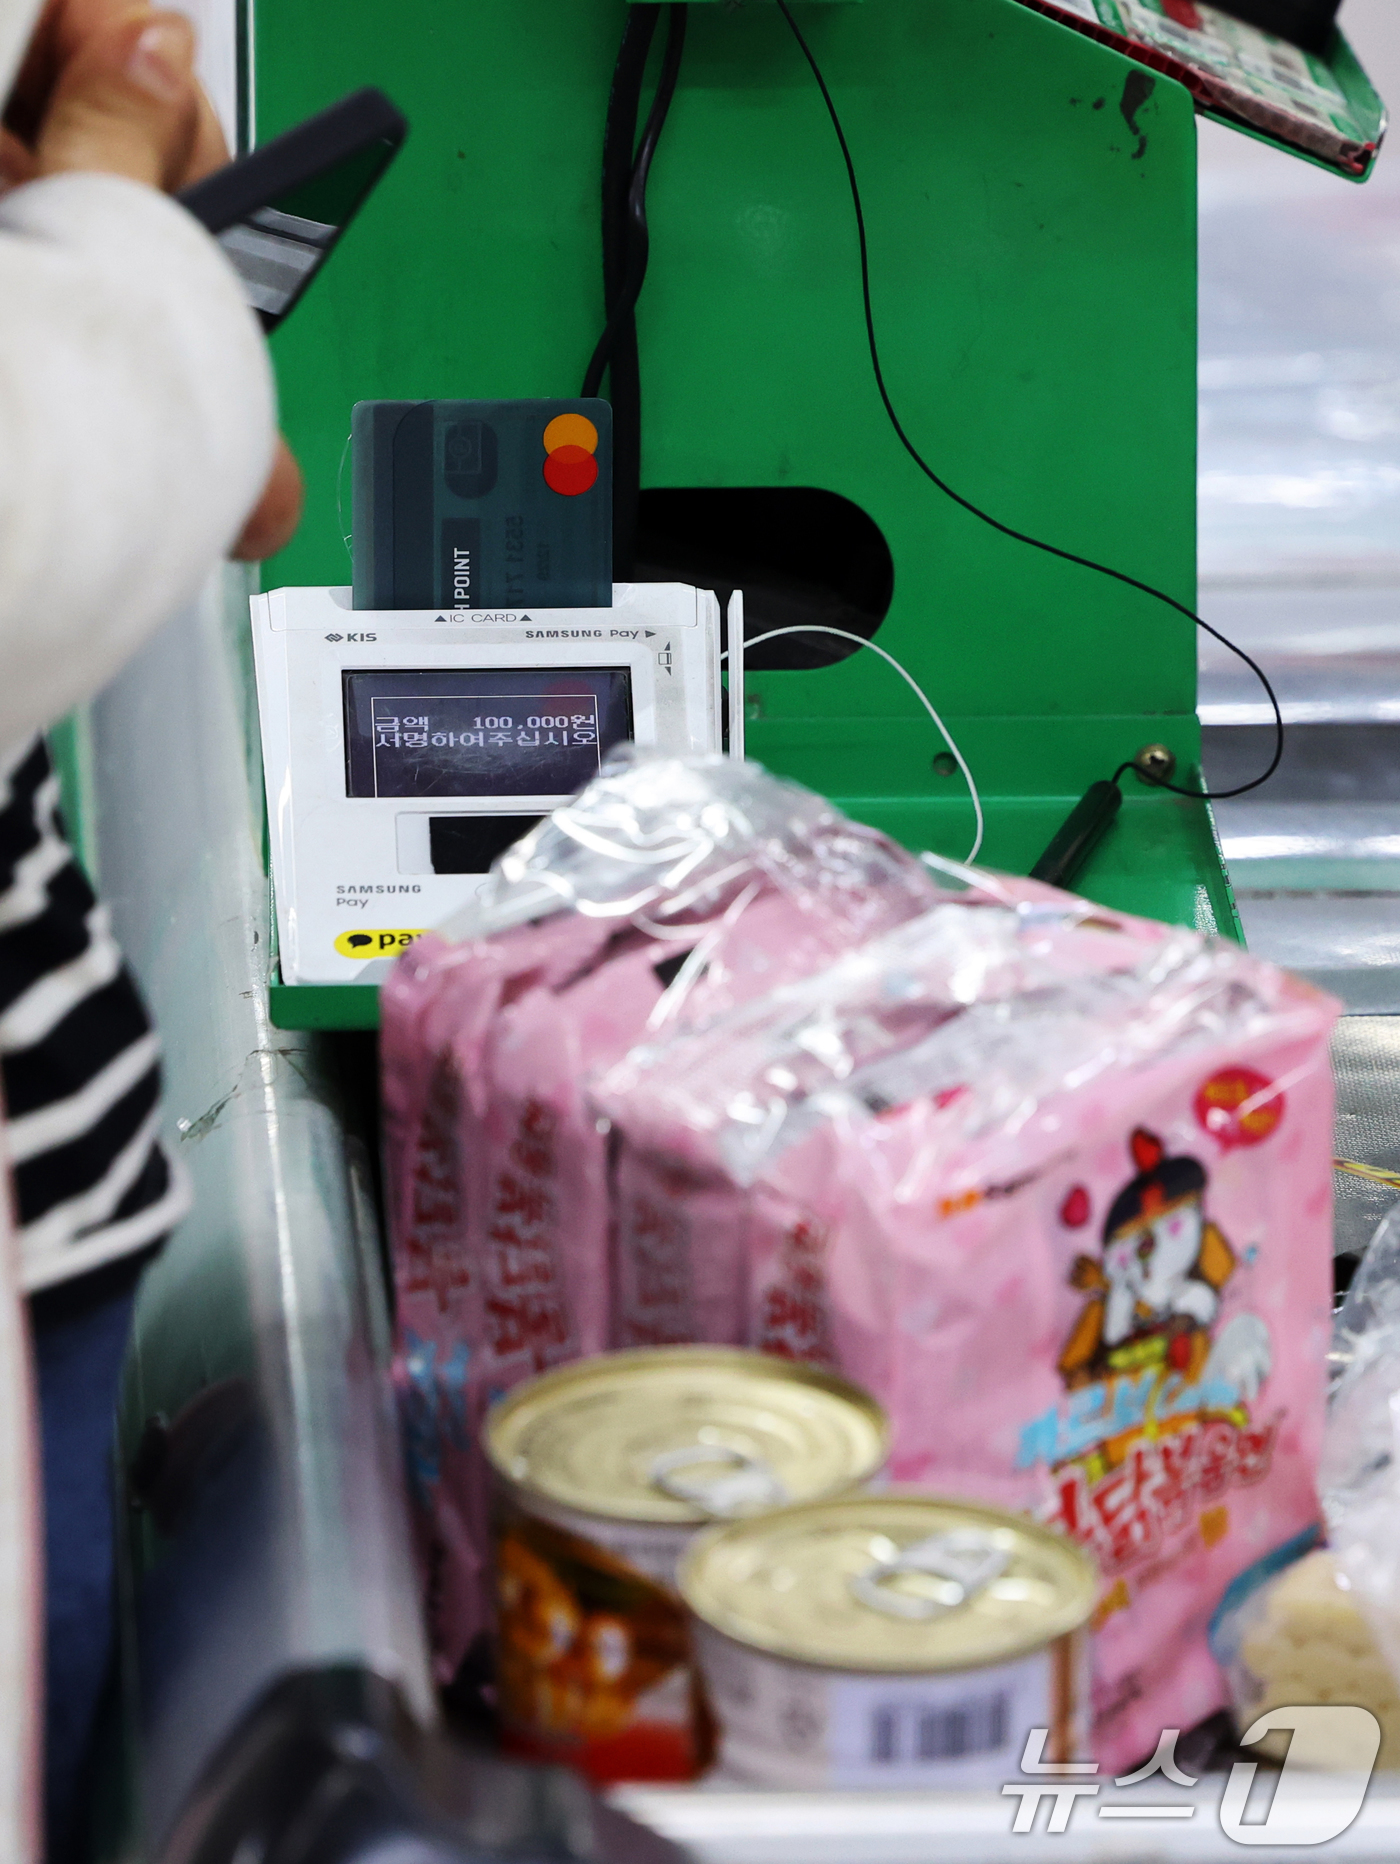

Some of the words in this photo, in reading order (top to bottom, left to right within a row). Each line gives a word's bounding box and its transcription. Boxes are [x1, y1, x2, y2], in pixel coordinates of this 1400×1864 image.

[453, 547, 470, 599] POINT
[449, 613, 465, 622] IC
[471, 613, 517, 622] CARD
[346, 632, 378, 642] KIS
[525, 629, 603, 638] SAMSUNG
[609, 629, 639, 640] Pay
[375, 716, 429, 732] 금액
[473, 714, 595, 730] 100,000원
[376, 730, 598, 748] 서명하여주십시오
[336, 884, 422, 894] SAMSUNG
[336, 898, 369, 909] Pay
